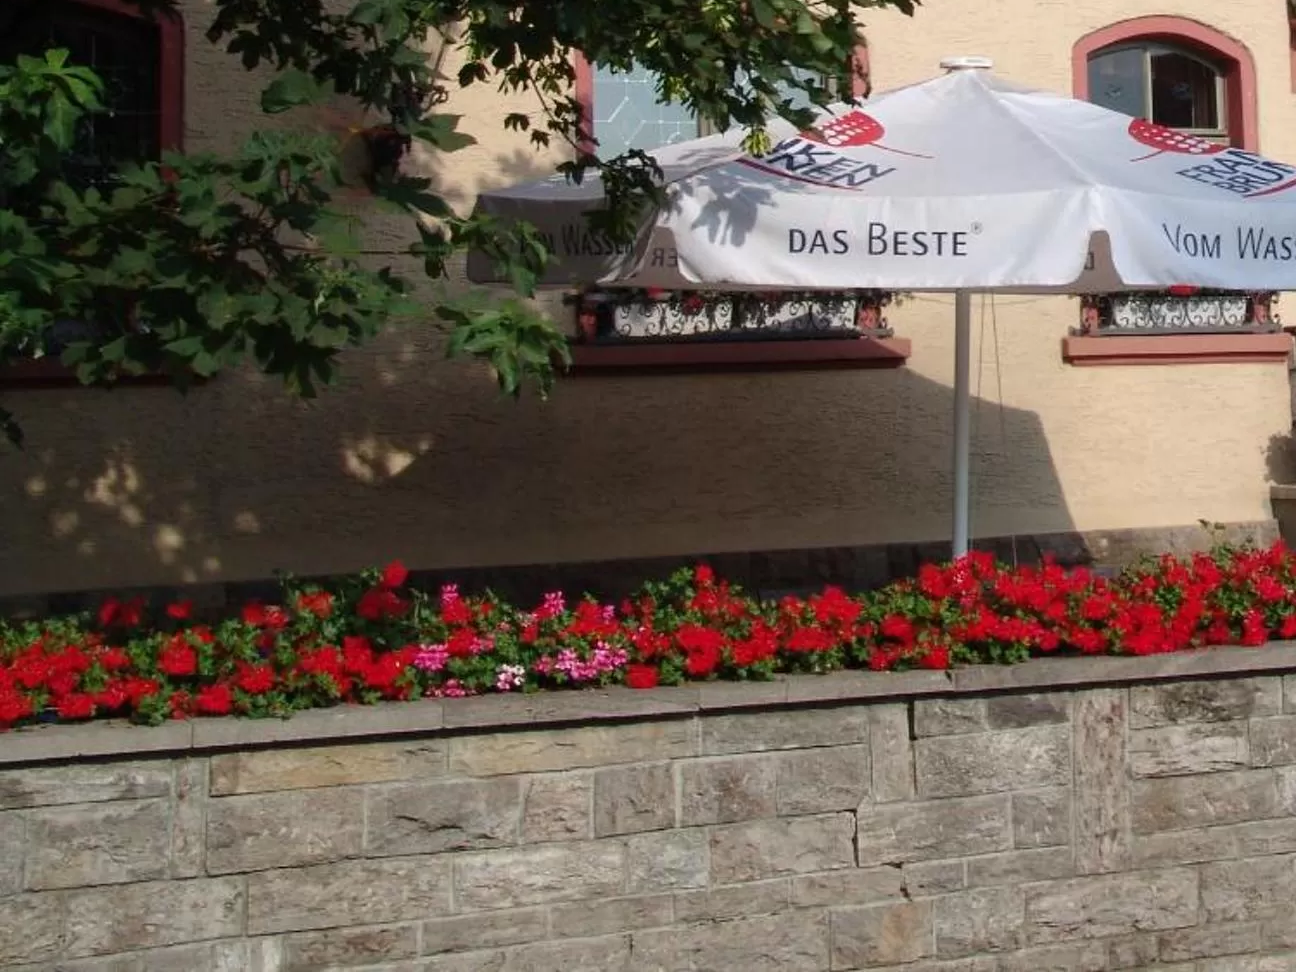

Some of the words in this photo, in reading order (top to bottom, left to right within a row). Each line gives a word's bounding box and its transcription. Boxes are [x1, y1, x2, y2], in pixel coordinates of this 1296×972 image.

[1176, 149, 1260, 183] FRAN
[1212, 161, 1296, 193] BRUN
[788, 228, 849, 255] DAS
